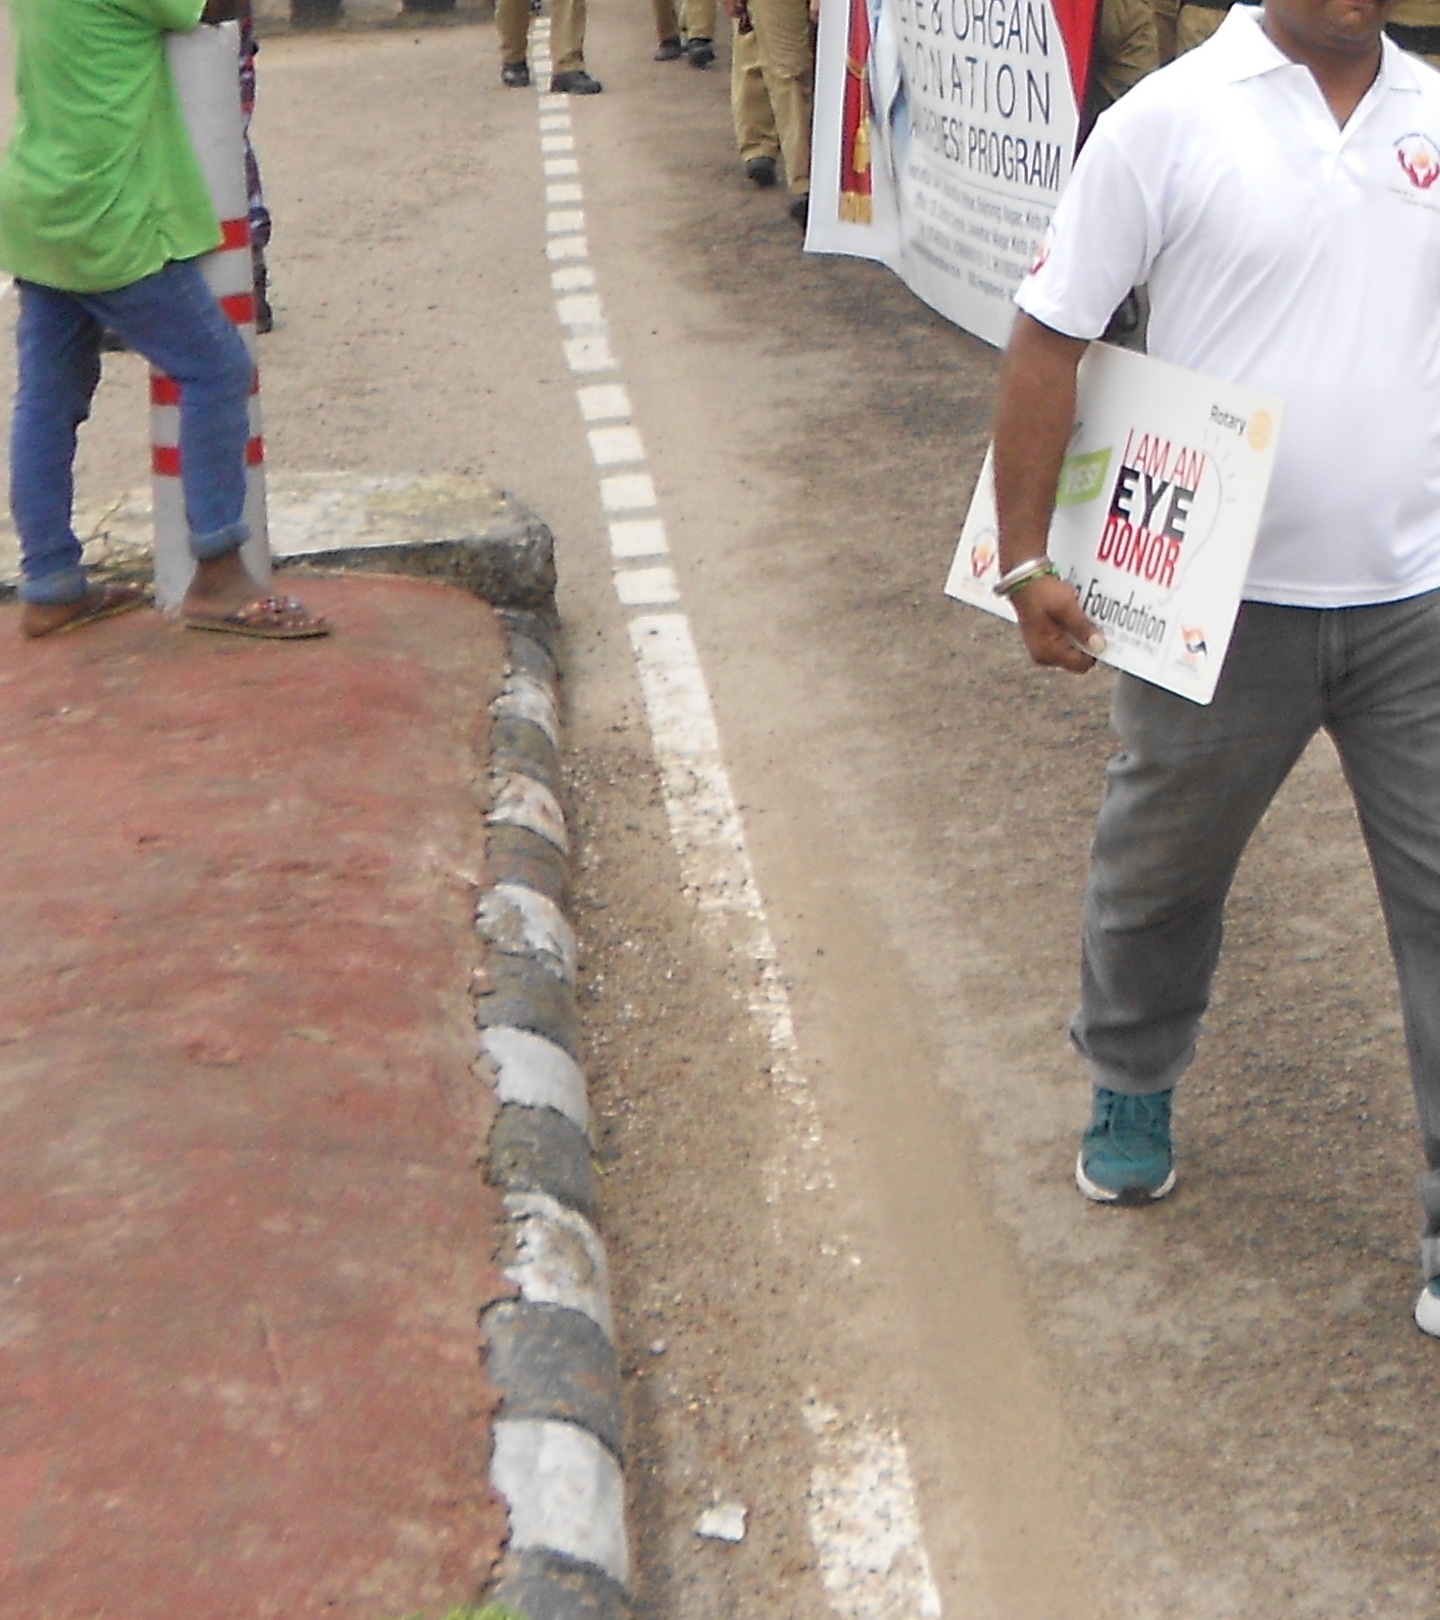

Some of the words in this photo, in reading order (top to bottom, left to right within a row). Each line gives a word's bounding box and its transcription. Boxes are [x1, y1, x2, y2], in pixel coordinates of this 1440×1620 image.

[907, 38, 1050, 125] ONATION
[968, 125, 1061, 193] PROGRAM
[1210, 404, 1247, 436] Rotary
[1131, 433, 1171, 478] AM
[1172, 446, 1206, 490] AN
[1108, 465, 1198, 541] EYE
[1097, 514, 1181, 589] DONOR
[1082, 578, 1167, 644] Foundation
